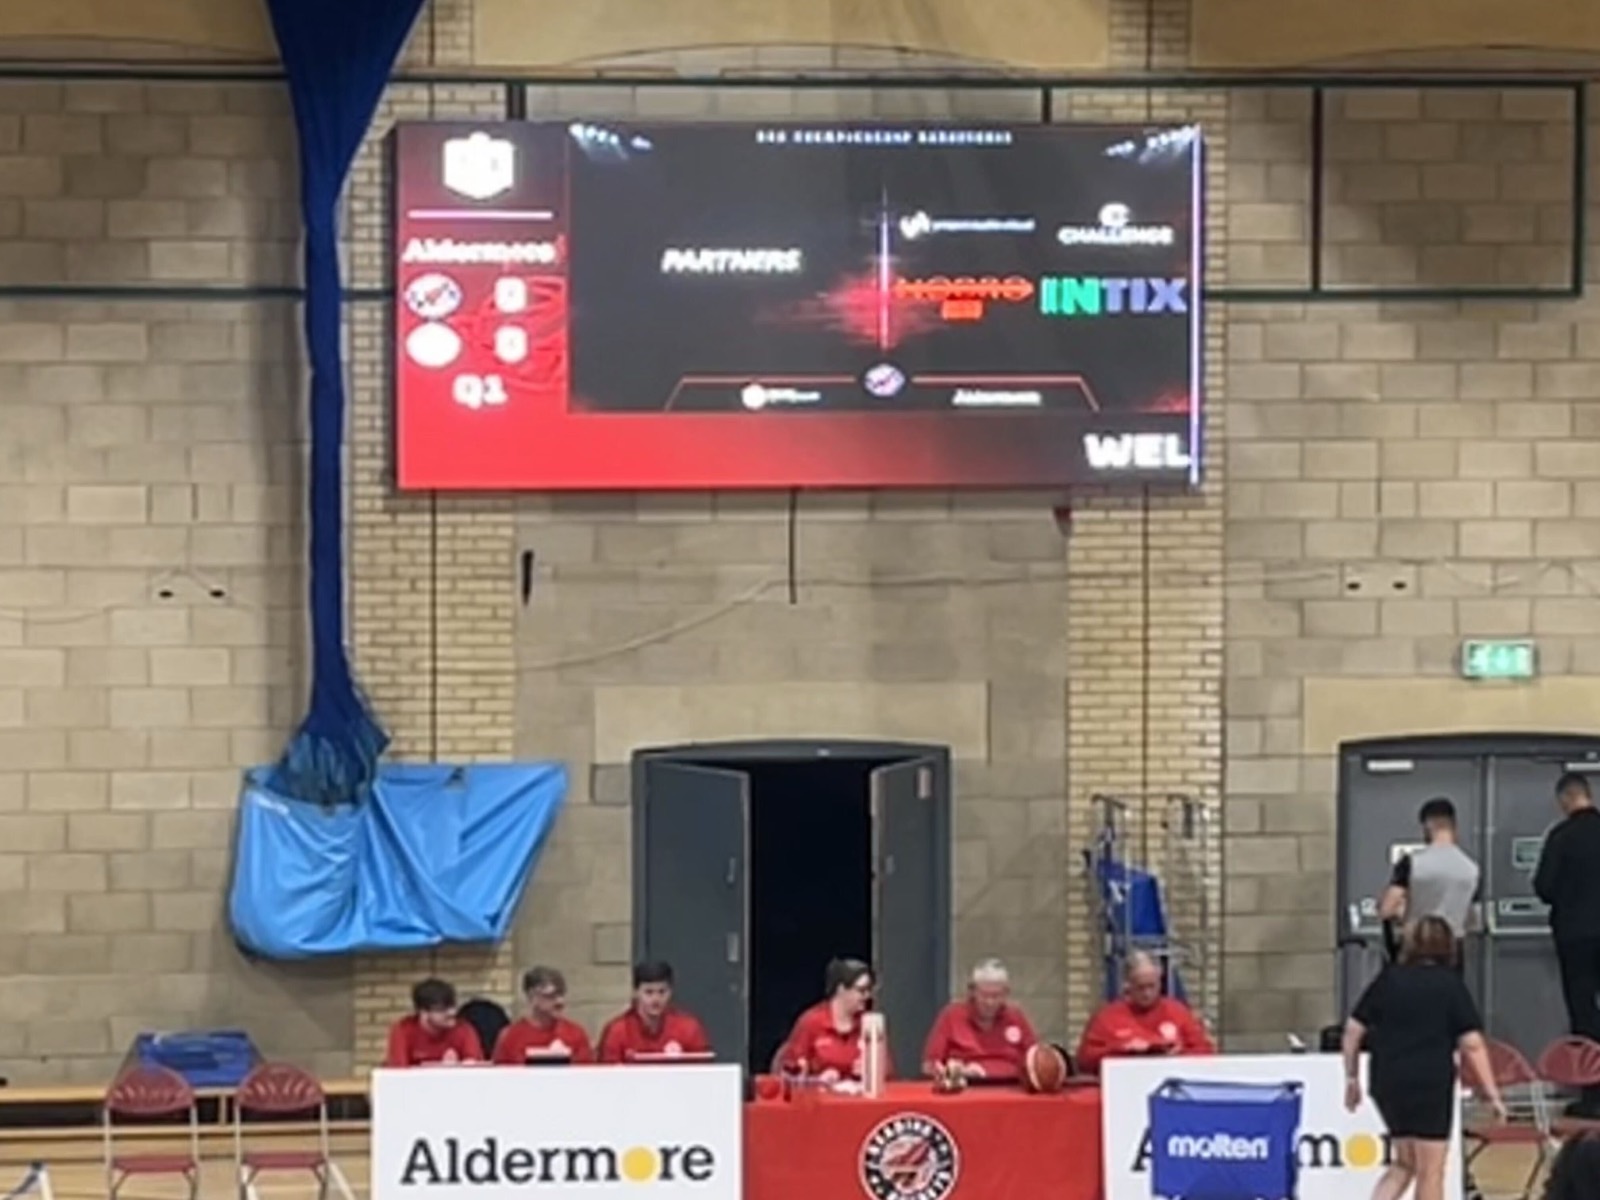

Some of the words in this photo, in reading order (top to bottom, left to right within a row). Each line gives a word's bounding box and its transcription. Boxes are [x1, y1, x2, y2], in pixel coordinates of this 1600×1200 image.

[1057, 225, 1173, 245] CHALLENGE
[661, 247, 802, 273] PARTNERS
[494, 276, 526, 312] 0
[1040, 276, 1187, 315] INTIX
[494, 325, 527, 362] 0
[453, 374, 508, 409] Q1
[1084, 432, 1191, 468] WEL
[400, 1137, 715, 1185] Aldermore
[1167, 1132, 1269, 1160] molten
